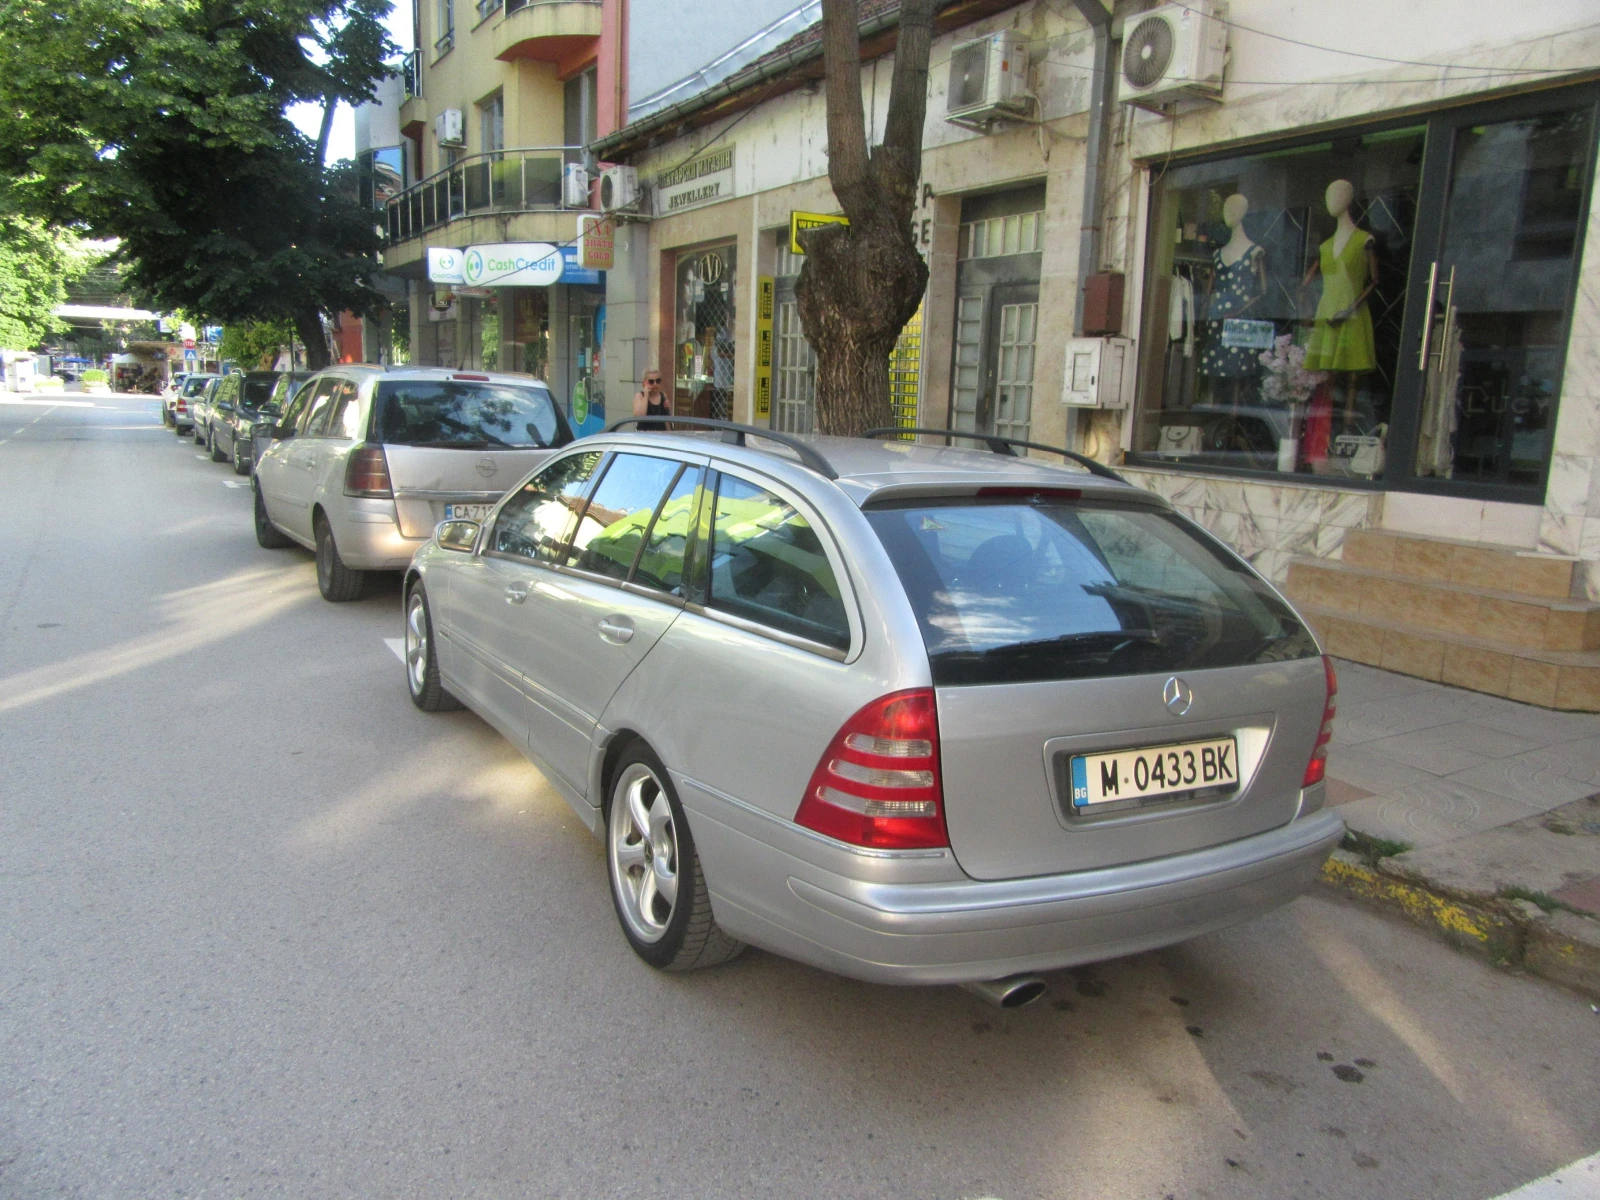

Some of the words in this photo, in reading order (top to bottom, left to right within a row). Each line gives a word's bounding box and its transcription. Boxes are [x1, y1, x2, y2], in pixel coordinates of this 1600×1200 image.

[698, 150, 732, 177] МАГАЗИН
[668, 182, 720, 209] JEWELLERY
[587, 251, 610, 260] GOLD
[487, 258, 556, 272] CashCredit
[1074, 788, 1087, 800] BG
